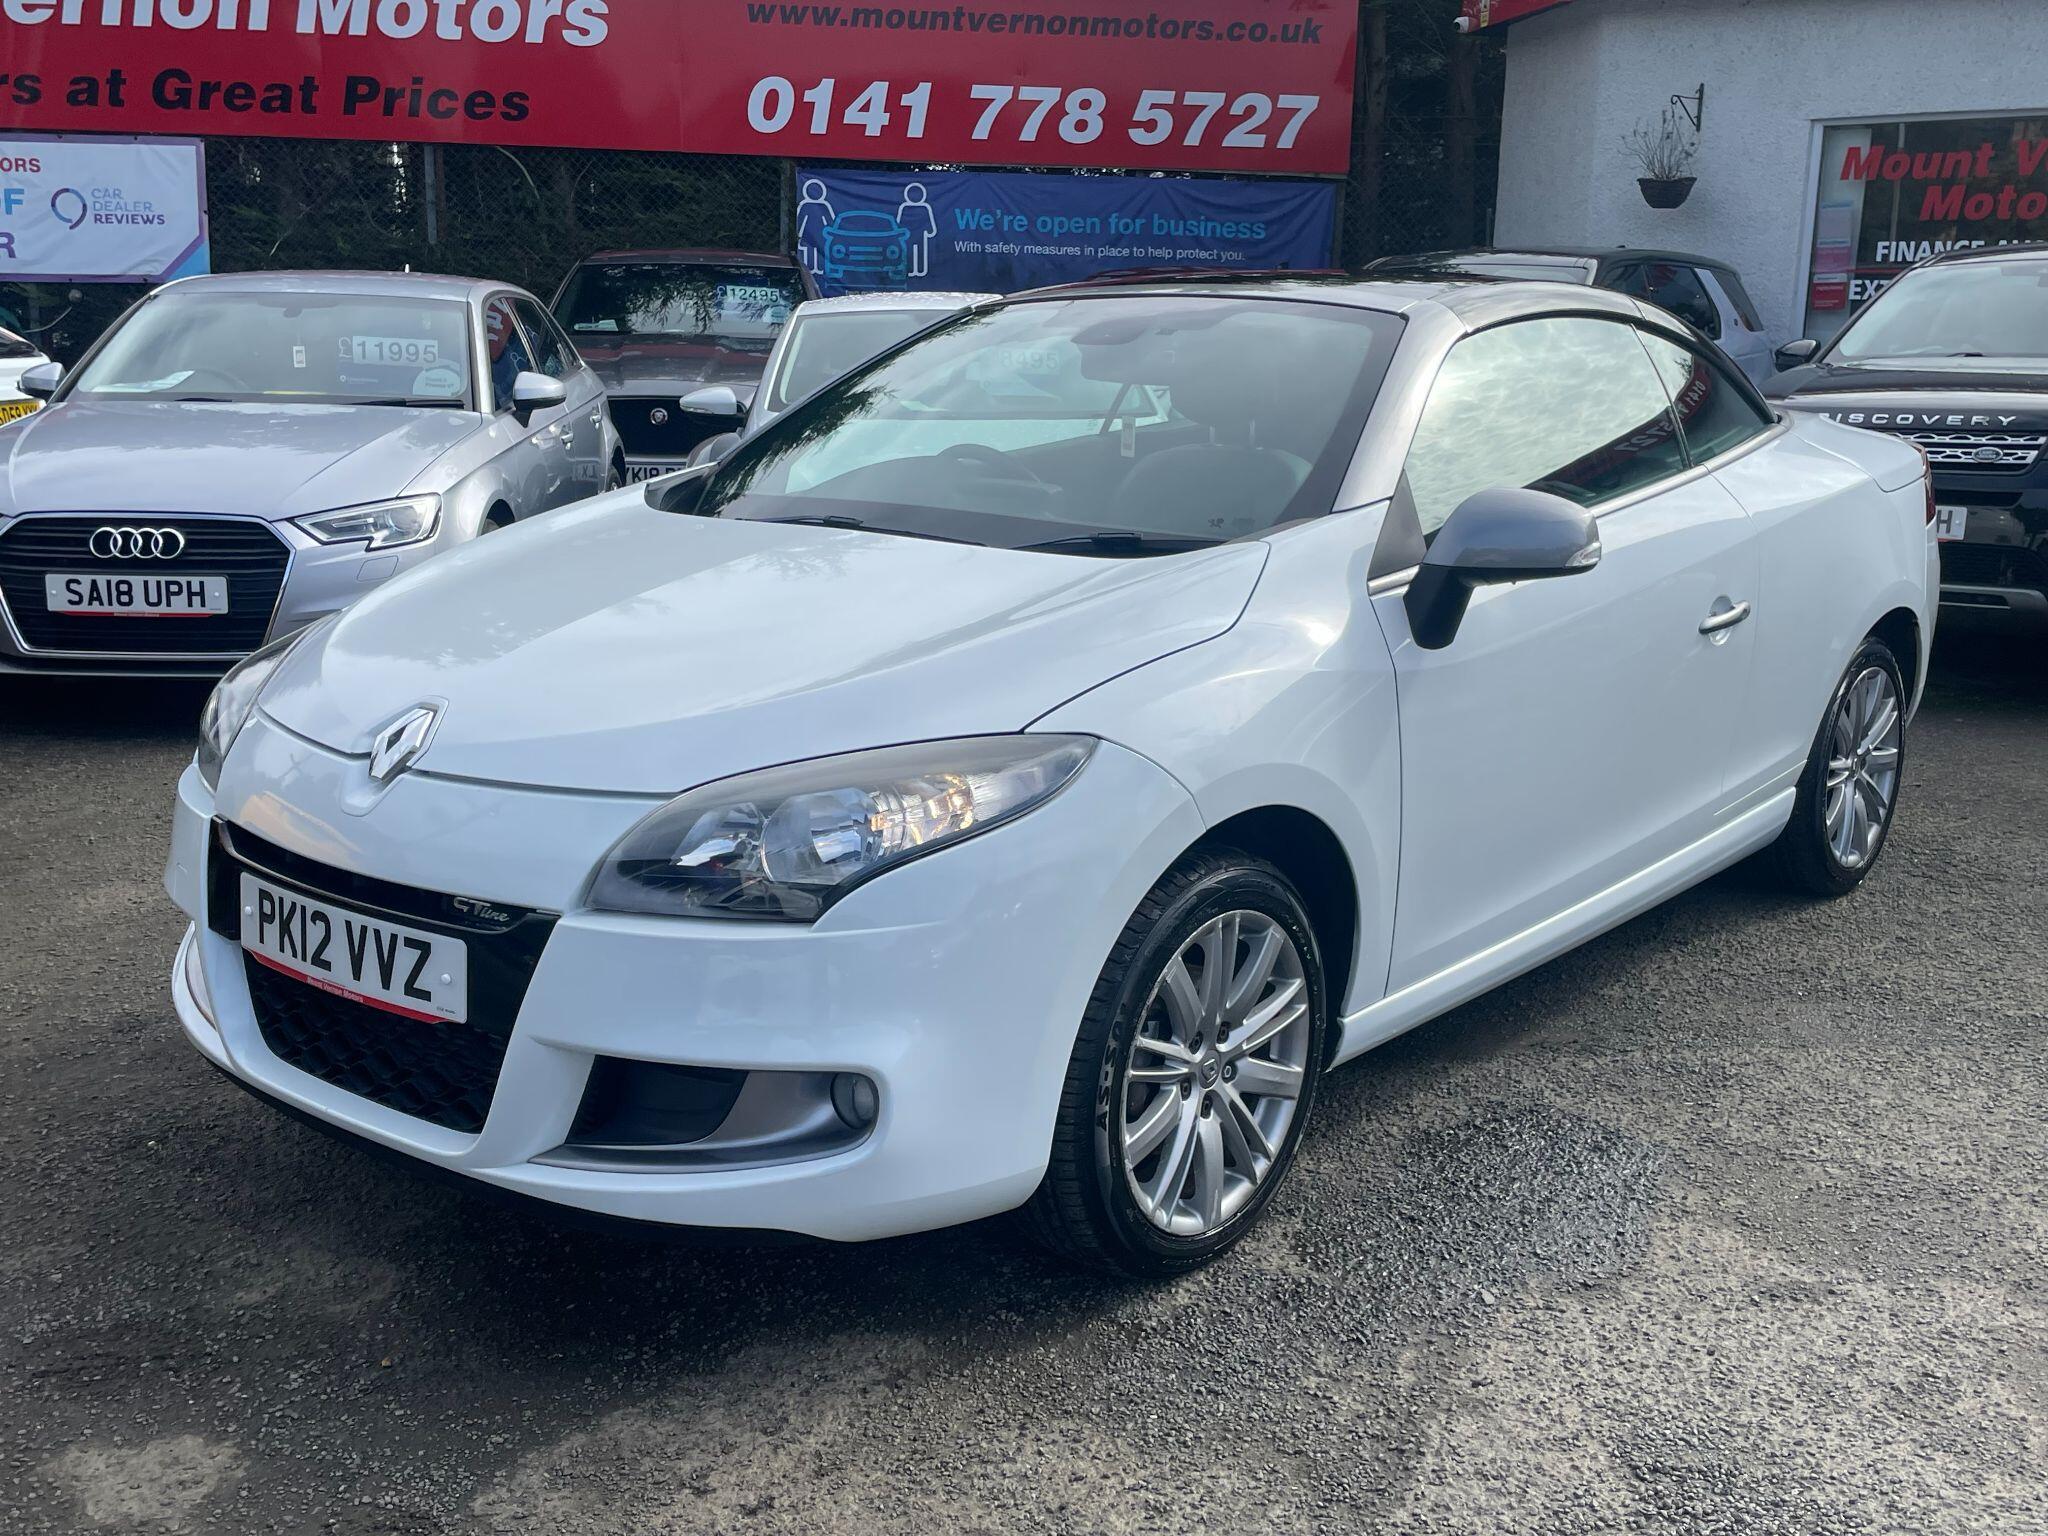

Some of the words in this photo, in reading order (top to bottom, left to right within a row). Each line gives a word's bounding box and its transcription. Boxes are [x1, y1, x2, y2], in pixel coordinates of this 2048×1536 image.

[295, 0, 608, 46] Motors
[747, 3, 1325, 44] www.mountvernonmotors.co.uk
[66, 68, 127, 107] at
[152, 68, 320, 114] Great
[343, 75, 530, 121] Prices
[747, 76, 932, 138] 0141
[970, 84, 1107, 144] 778
[1127, 89, 1320, 149] 5727
[1840, 143, 1995, 181] Mount
[91, 188, 124, 200] CAR
[92, 201, 155, 213] DEALER
[94, 213, 166, 225] REVIEWS
[954, 208, 1029, 232] We're
[1036, 215, 1101, 237] open
[1108, 212, 1147, 235] for
[1153, 213, 1267, 239] business
[954, 240, 982, 253] With
[984, 242, 1021, 256] safety
[1023, 244, 1081, 256] measures
[1084, 244, 1095, 256] in
[1098, 245, 1131, 259] place
[1132, 246, 1146, 258] to
[1149, 247, 1173, 260] help
[1176, 248, 1218, 261] protect
[1220, 250, 1246, 263] you.
[65, 578, 134, 607] SA18
[143, 580, 207, 608] UPH
[258, 887, 332, 973] PK12
[345, 919, 432, 1003] VVZ
